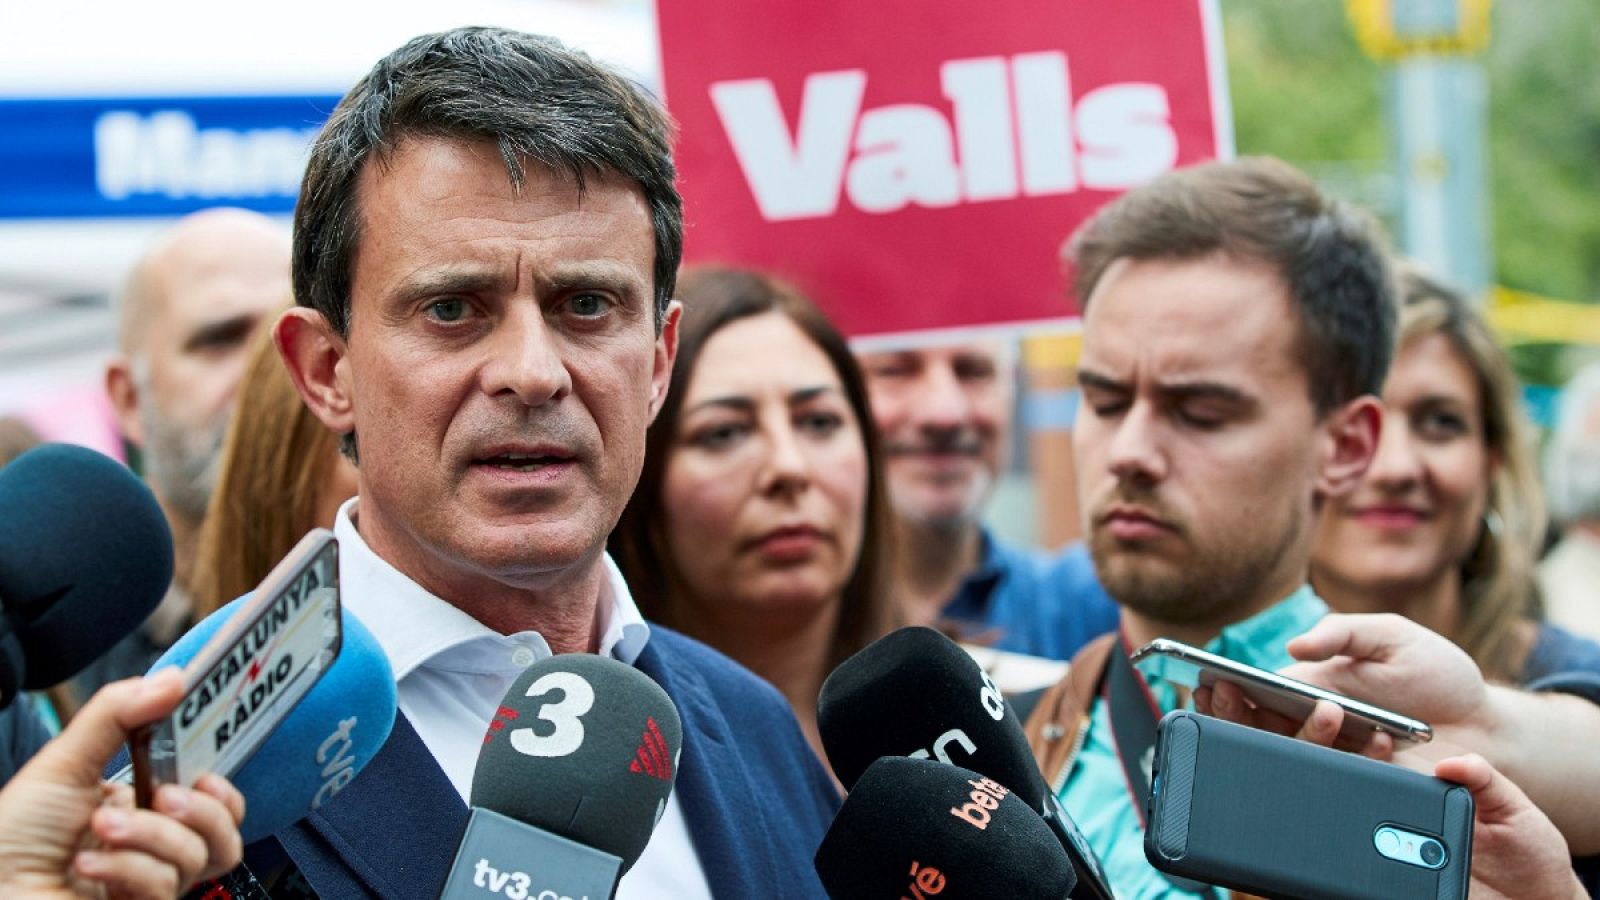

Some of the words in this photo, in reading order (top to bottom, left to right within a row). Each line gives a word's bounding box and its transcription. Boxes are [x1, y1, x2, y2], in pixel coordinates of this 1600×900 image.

[709, 50, 1178, 221] Valls
[179, 564, 320, 729] CATALUNYA
[510, 671, 595, 757] 3
